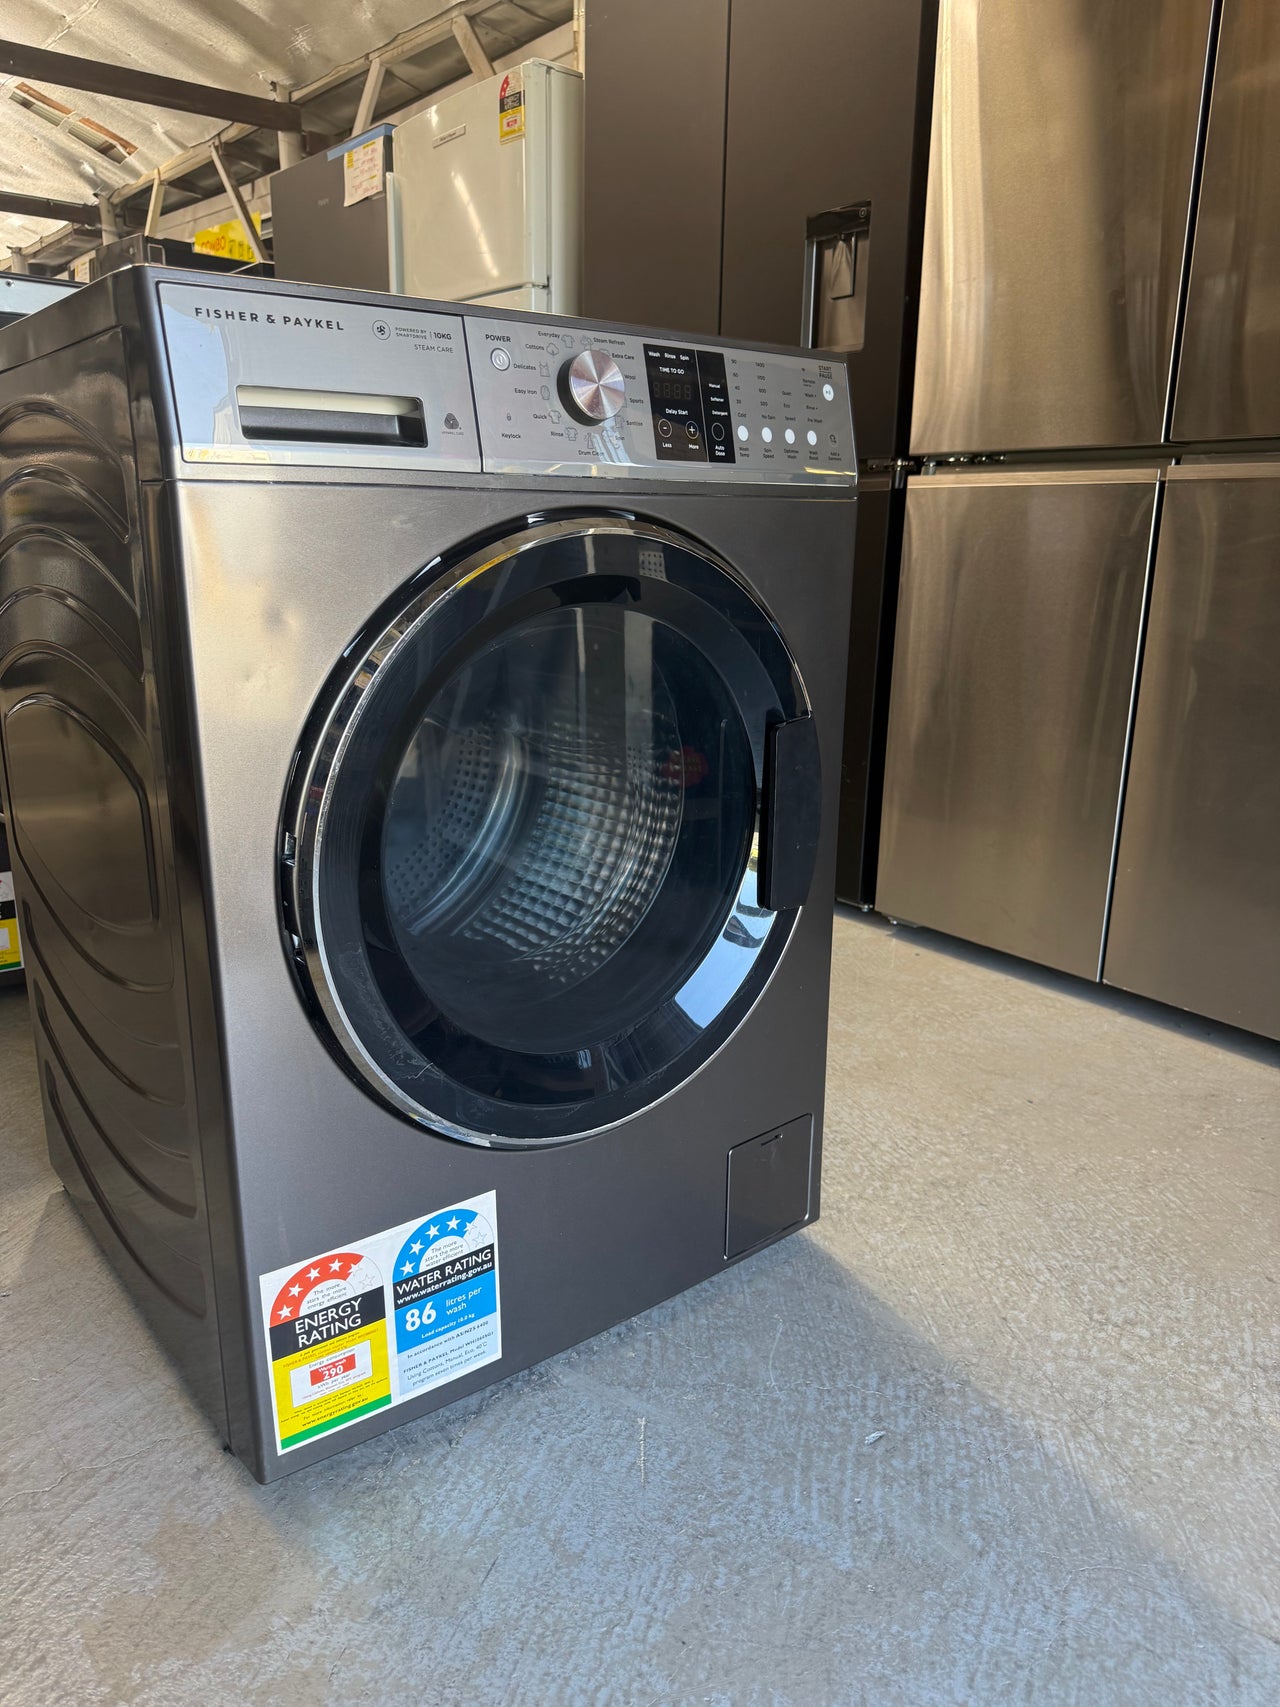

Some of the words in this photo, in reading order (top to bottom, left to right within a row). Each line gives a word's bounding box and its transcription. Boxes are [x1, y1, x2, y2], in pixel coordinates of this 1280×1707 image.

[195, 307, 259, 322] FISHER
[266, 314, 276, 324] &
[283, 316, 345, 331] PAYKEL
[433, 331, 452, 340] 10KG
[485, 334, 511, 343] POWER
[538, 331, 560, 339] Everyday
[414, 344, 435, 352] STEAM
[436, 346, 454, 354] CARE
[525, 343, 544, 351] Cottons
[513, 363, 536, 371] Delicates
[443, 1240, 458, 1249] more
[424, 1254, 438, 1262] stars
[449, 1243, 464, 1252] more
[425, 1260, 441, 1268] water
[442, 1249, 464, 1261] efficient
[396, 1270, 442, 1295] WATER
[445, 1249, 492, 1277] RATING
[326, 1283, 341, 1291] more
[396, 1261, 493, 1305] www.waterrating.gov.au
[332, 1287, 347, 1295] more
[445, 1294, 466, 1308] litres
[468, 1287, 482, 1299] per
[307, 1301, 325, 1310] energy
[327, 1292, 347, 1302] efficient
[295, 1297, 362, 1334] ENERGY
[446, 1302, 467, 1316] wash
[405, 1301, 437, 1332] 86
[298, 1313, 362, 1349] RATING
[421, 1330, 435, 1339] Load
[435, 1321, 457, 1334] capacity
[443, 1335, 456, 1343] with
[309, 1360, 325, 1369] Energy
[403, 1362, 423, 1373] FISHER
[428, 1351, 449, 1363] PAYKEL
[449, 1345, 465, 1354] Model
[322, 1364, 344, 1381] 290
[407, 1370, 422, 1381] Using
[412, 1373, 435, 1387] program
